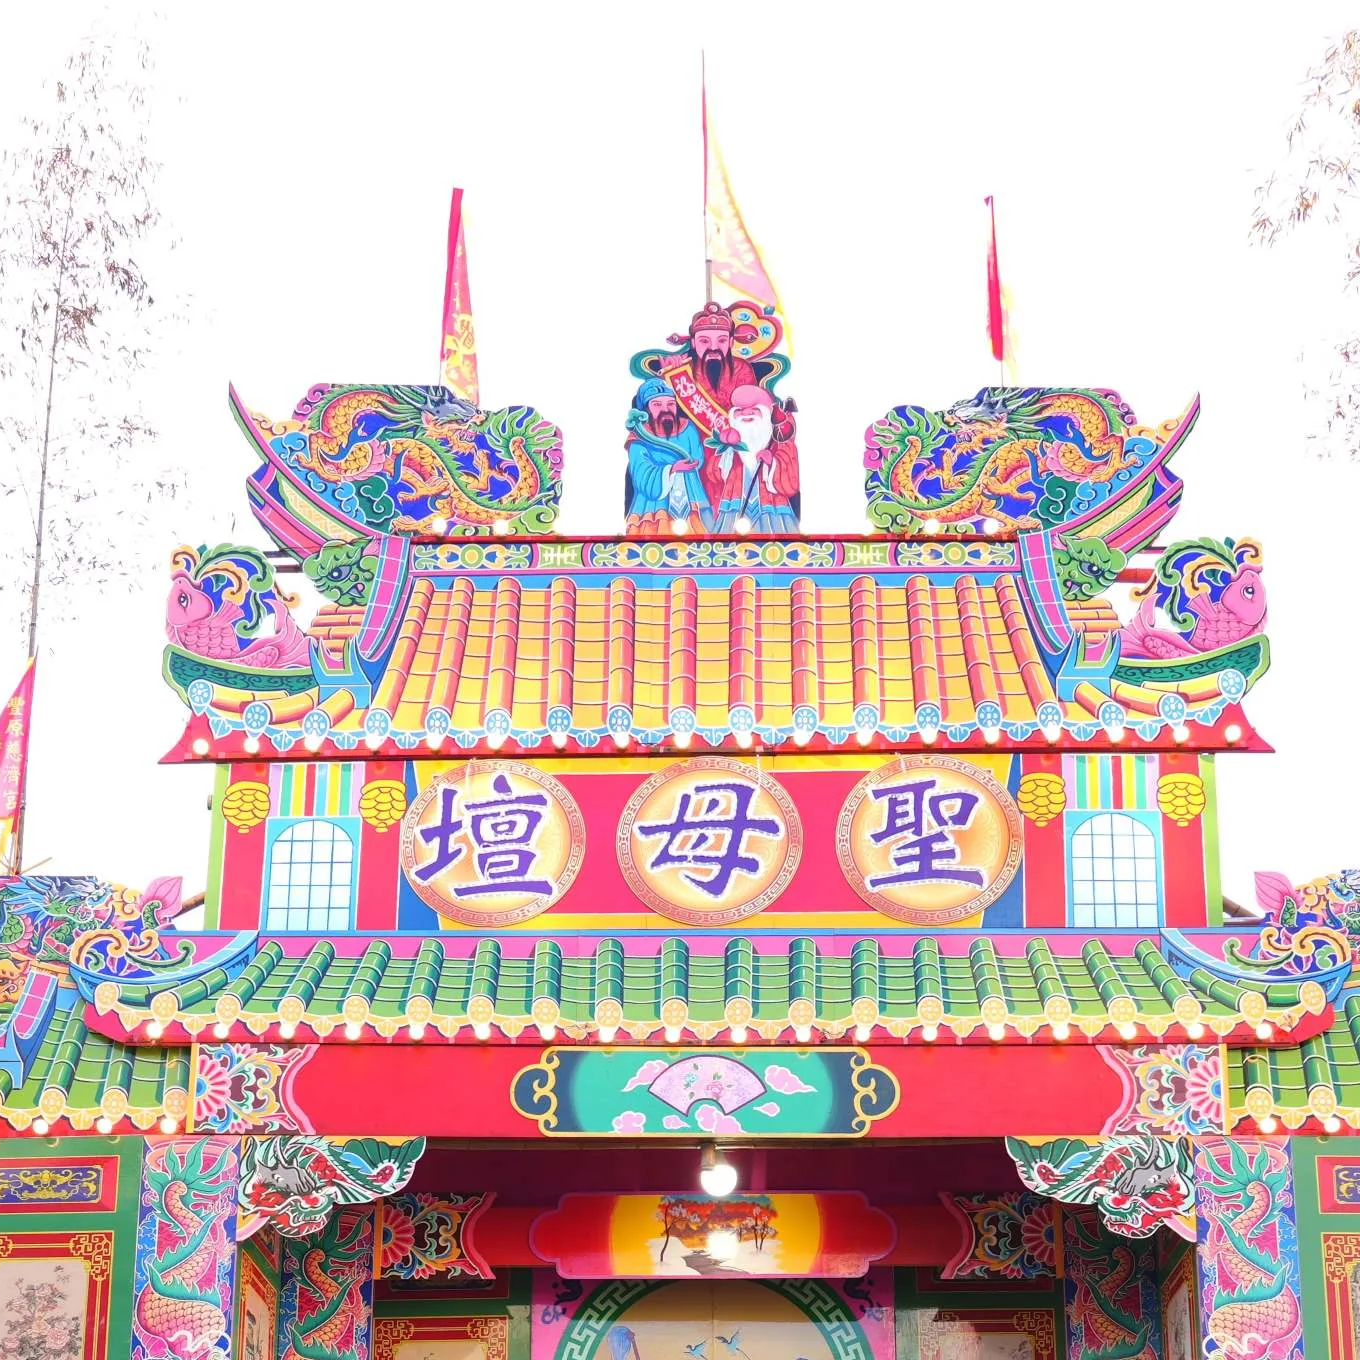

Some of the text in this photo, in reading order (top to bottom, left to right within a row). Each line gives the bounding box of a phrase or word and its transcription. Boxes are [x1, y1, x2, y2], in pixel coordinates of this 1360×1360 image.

[3, 697, 27, 811] 豐原慈濟宮
[410, 773, 987, 903] 聖母壇
